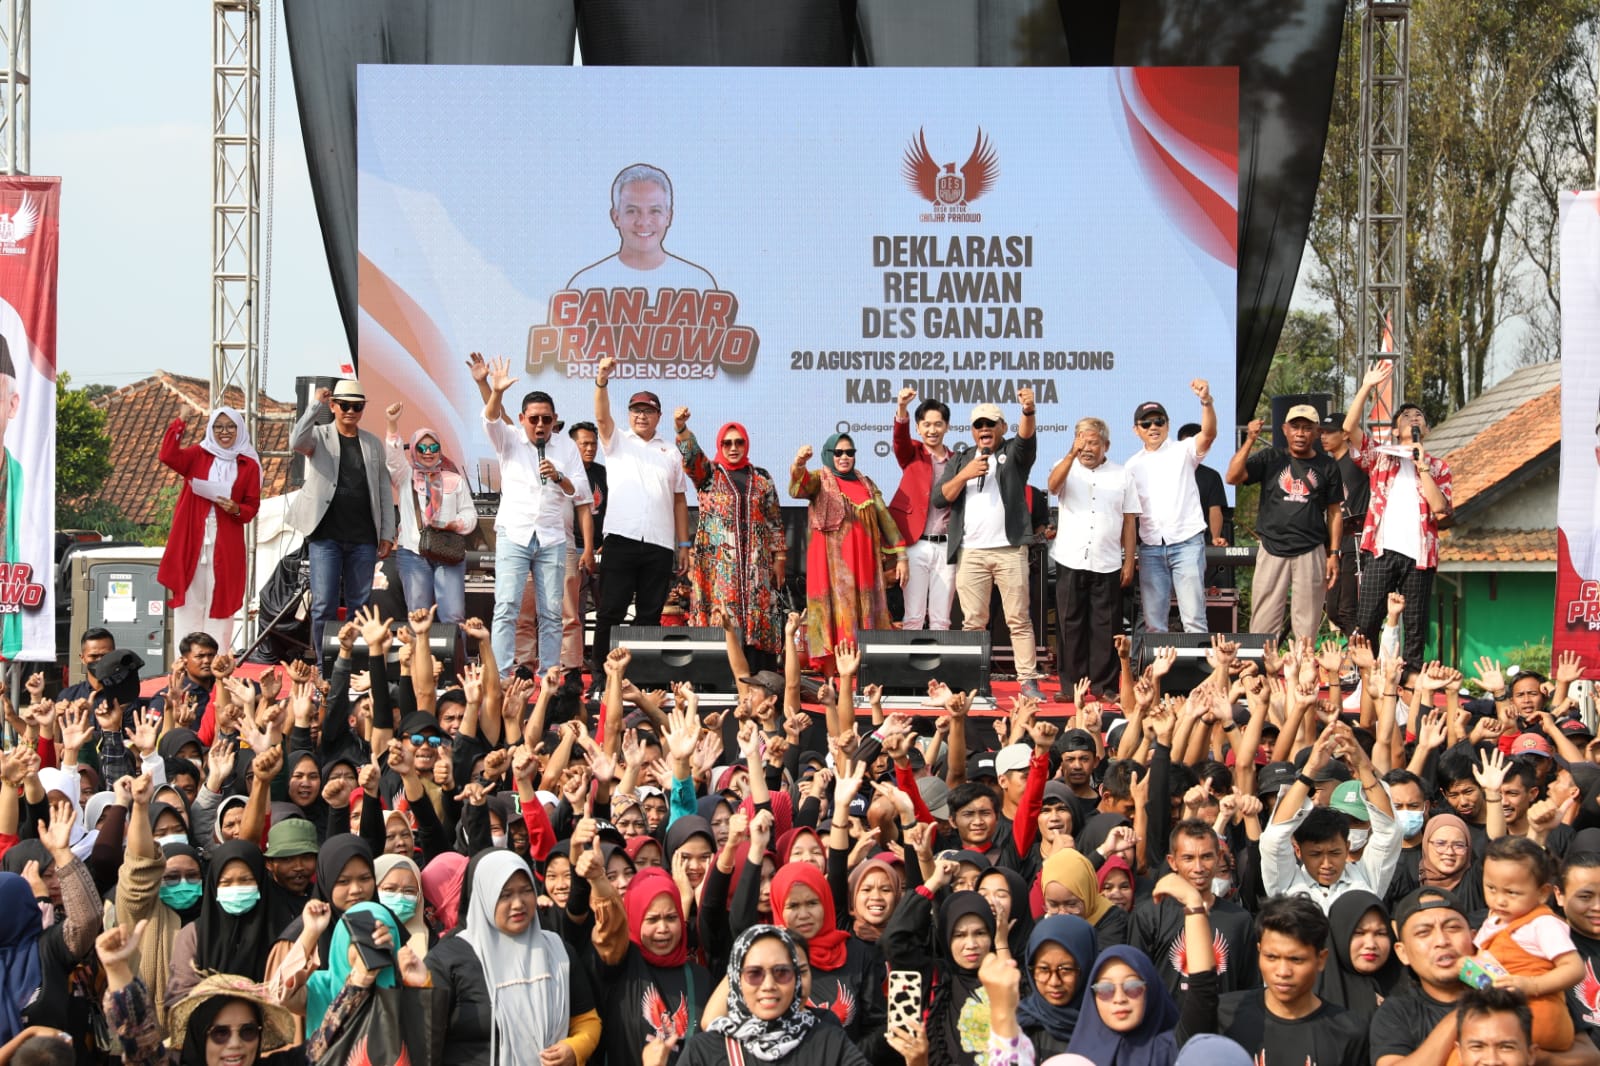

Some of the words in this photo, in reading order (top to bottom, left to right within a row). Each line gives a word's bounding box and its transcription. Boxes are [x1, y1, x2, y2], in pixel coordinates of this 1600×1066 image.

[941, 177, 960, 189] DES
[873, 236, 1033, 267] DEKLARASI
[884, 271, 1022, 303] RELAWAN
[550, 289, 734, 328] GANJAR
[862, 307, 916, 338] DES
[923, 307, 1044, 338] GANJAR
[529, 325, 757, 365] PRANOWO
[566, 363, 661, 378] PREIDEN
[665, 363, 715, 378] 2024
[791, 351, 814, 370] 20
[816, 351, 896, 370] AGUSTUS
[899, 351, 950, 374] 2022,
[953, 351, 987, 370] LAP.
[990, 351, 1040, 370] PILAR
[1043, 351, 1114, 370] BOJONG
[846, 378, 898, 403] KAB.
[1225, 547, 1249, 556] KORG
